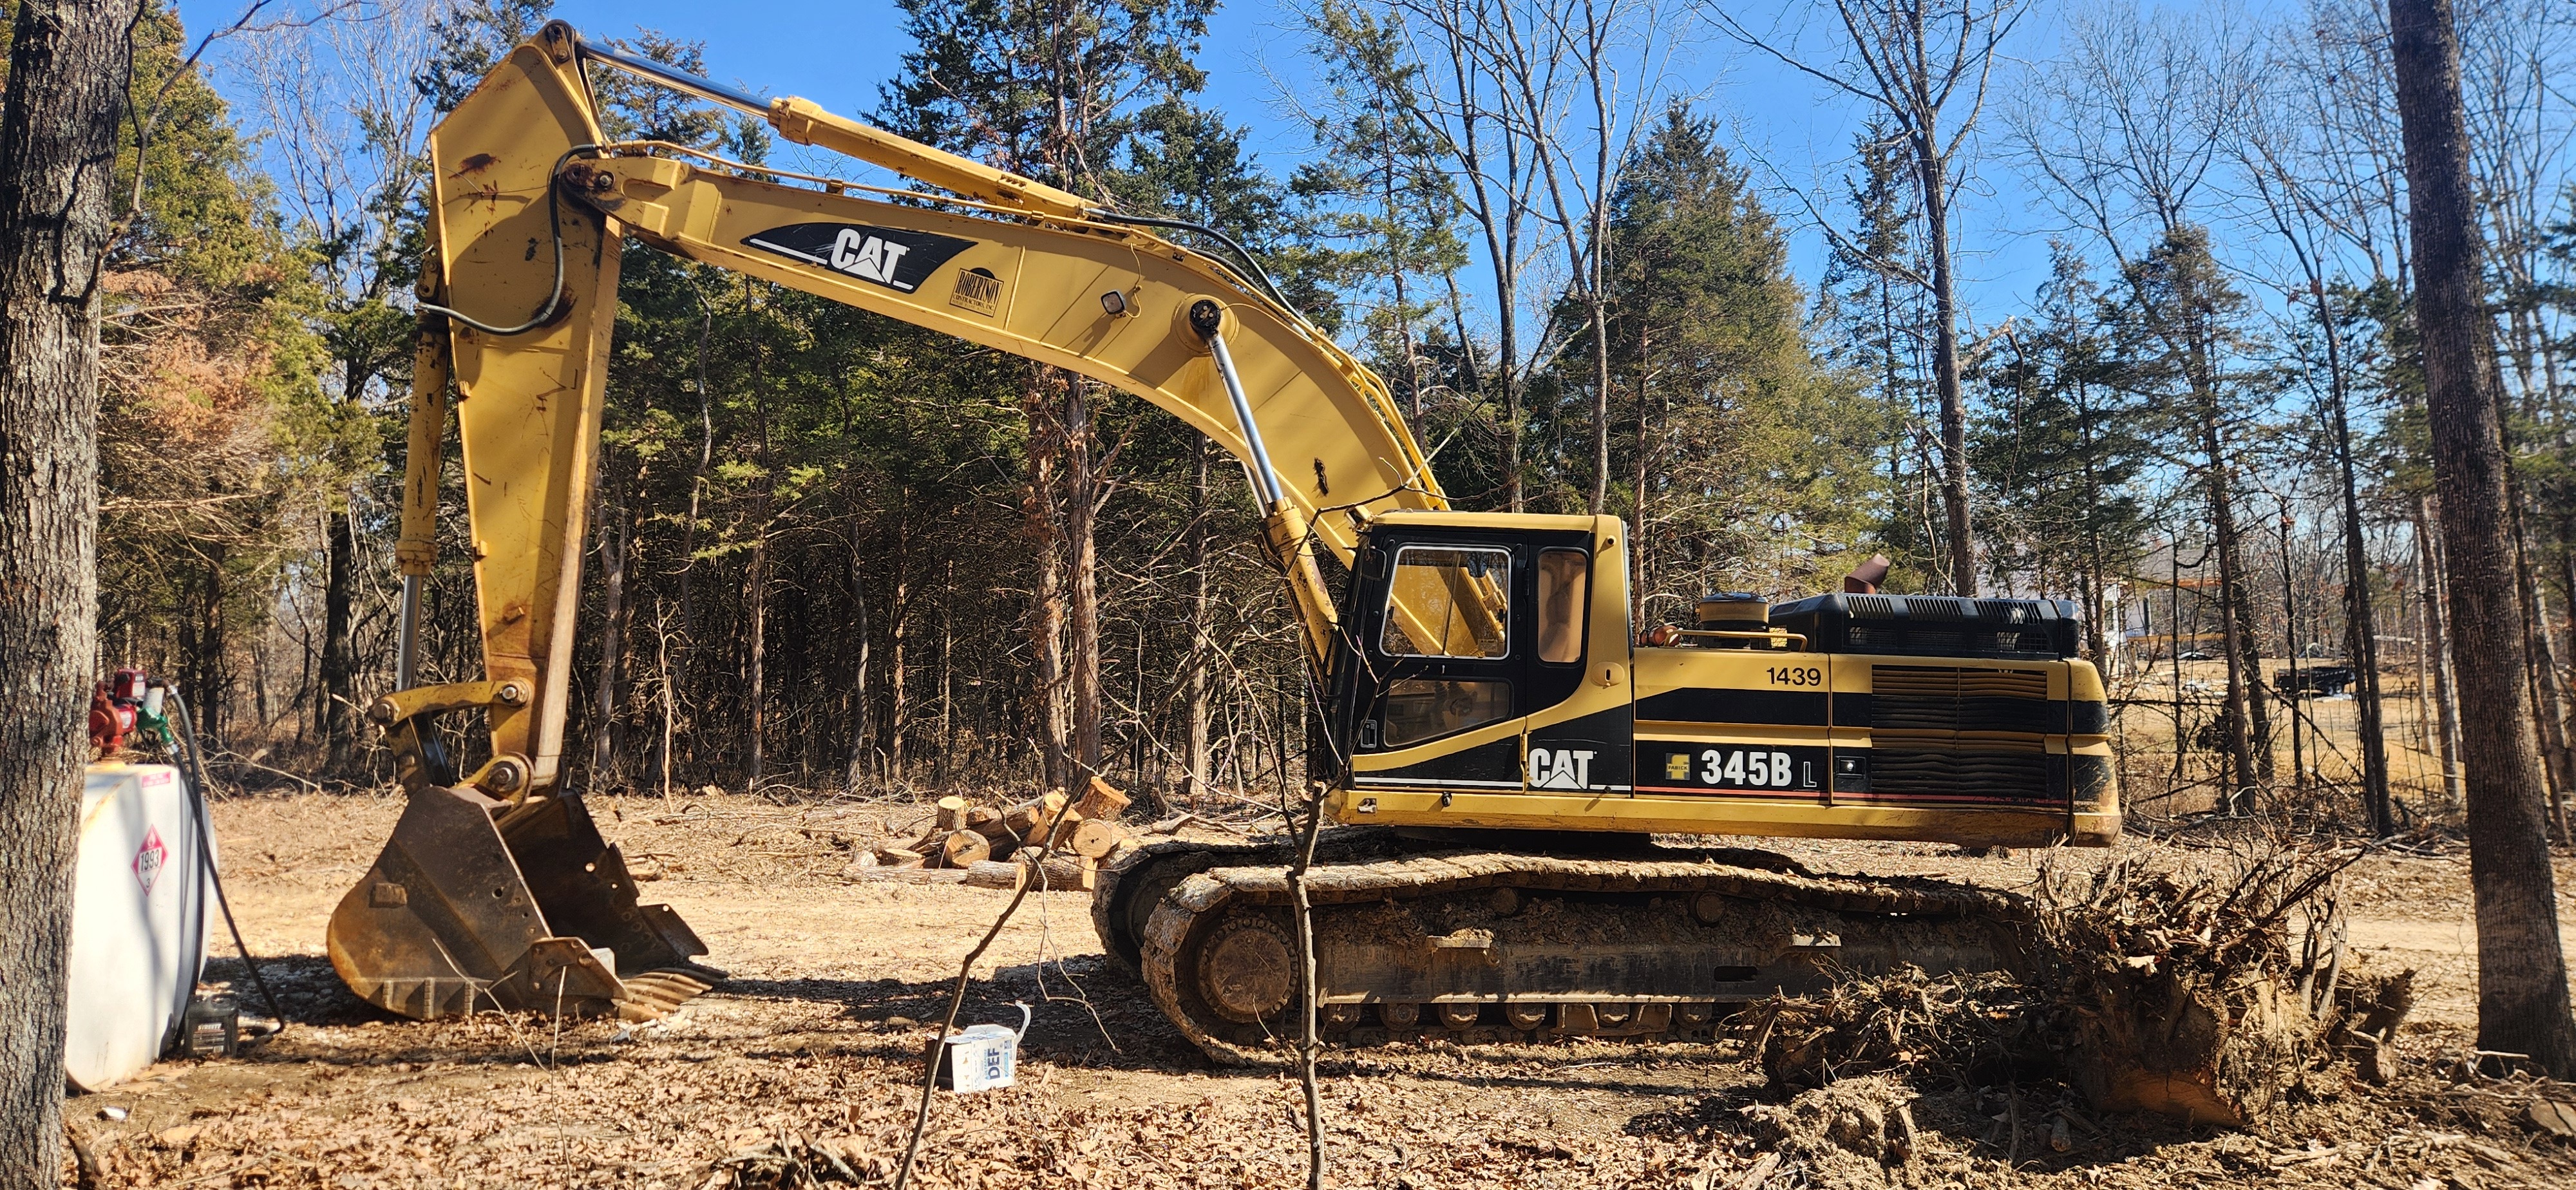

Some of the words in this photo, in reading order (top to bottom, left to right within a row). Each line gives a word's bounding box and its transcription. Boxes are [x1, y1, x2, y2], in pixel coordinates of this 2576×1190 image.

[831, 229, 907, 284] CAT
[955, 271, 1001, 305] ROBERTSON
[1766, 667, 1821, 686] 1439
[1529, 748, 1594, 789] CAT
[1701, 750, 1792, 786] 345B
[1803, 762, 1817, 787] L
[140, 849, 159, 871] 1993
[146, 878, 151, 888] 3
[987, 1048, 1001, 1080] DEF
